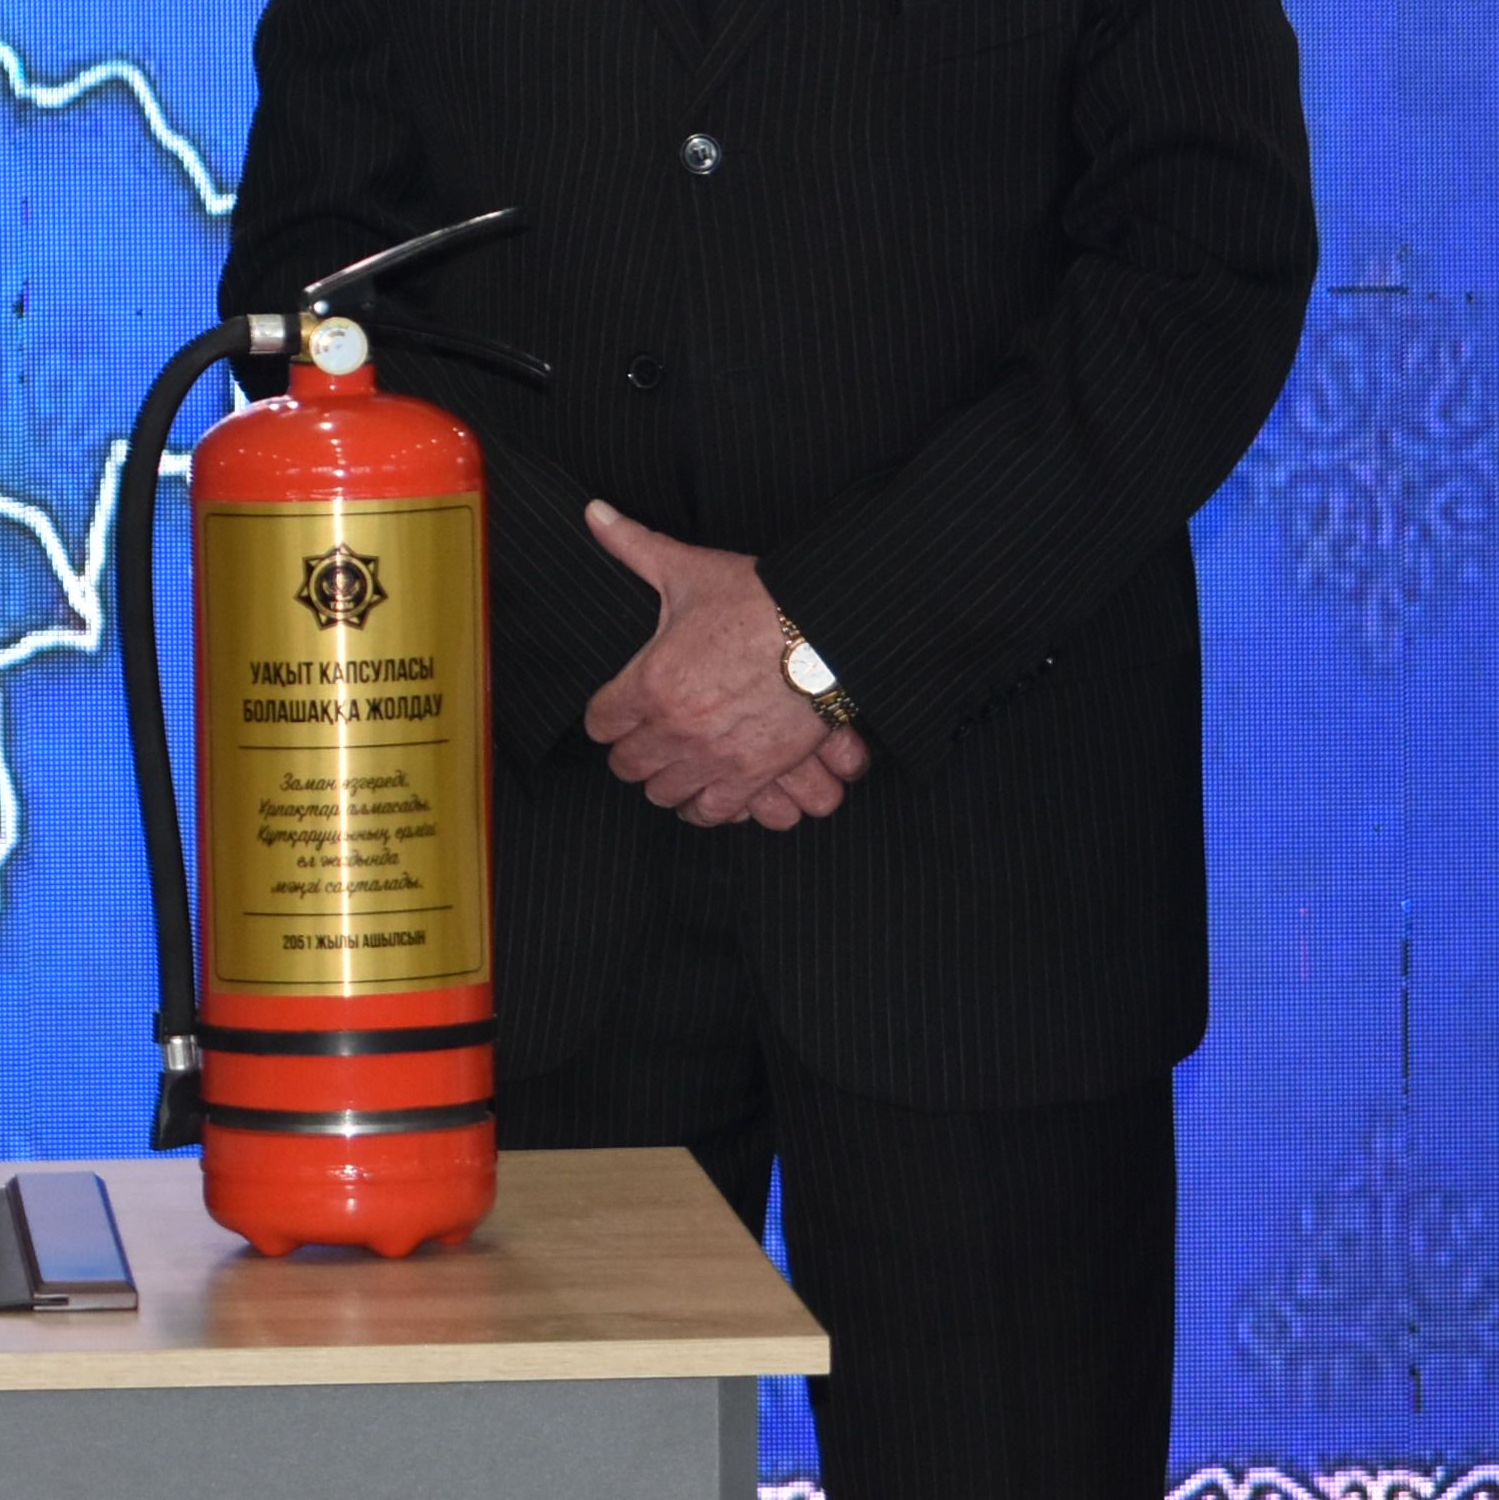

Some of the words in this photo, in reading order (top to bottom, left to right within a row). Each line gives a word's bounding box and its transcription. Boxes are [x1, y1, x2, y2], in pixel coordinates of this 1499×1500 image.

[250, 660, 314, 687] УАҚЫТ
[319, 656, 435, 685] КАПСУЛАСЫ
[243, 698, 361, 725] БОЛАШАҚҚА
[365, 693, 444, 721] ЖОЛДАУ
[279, 771, 338, 793] Заман
